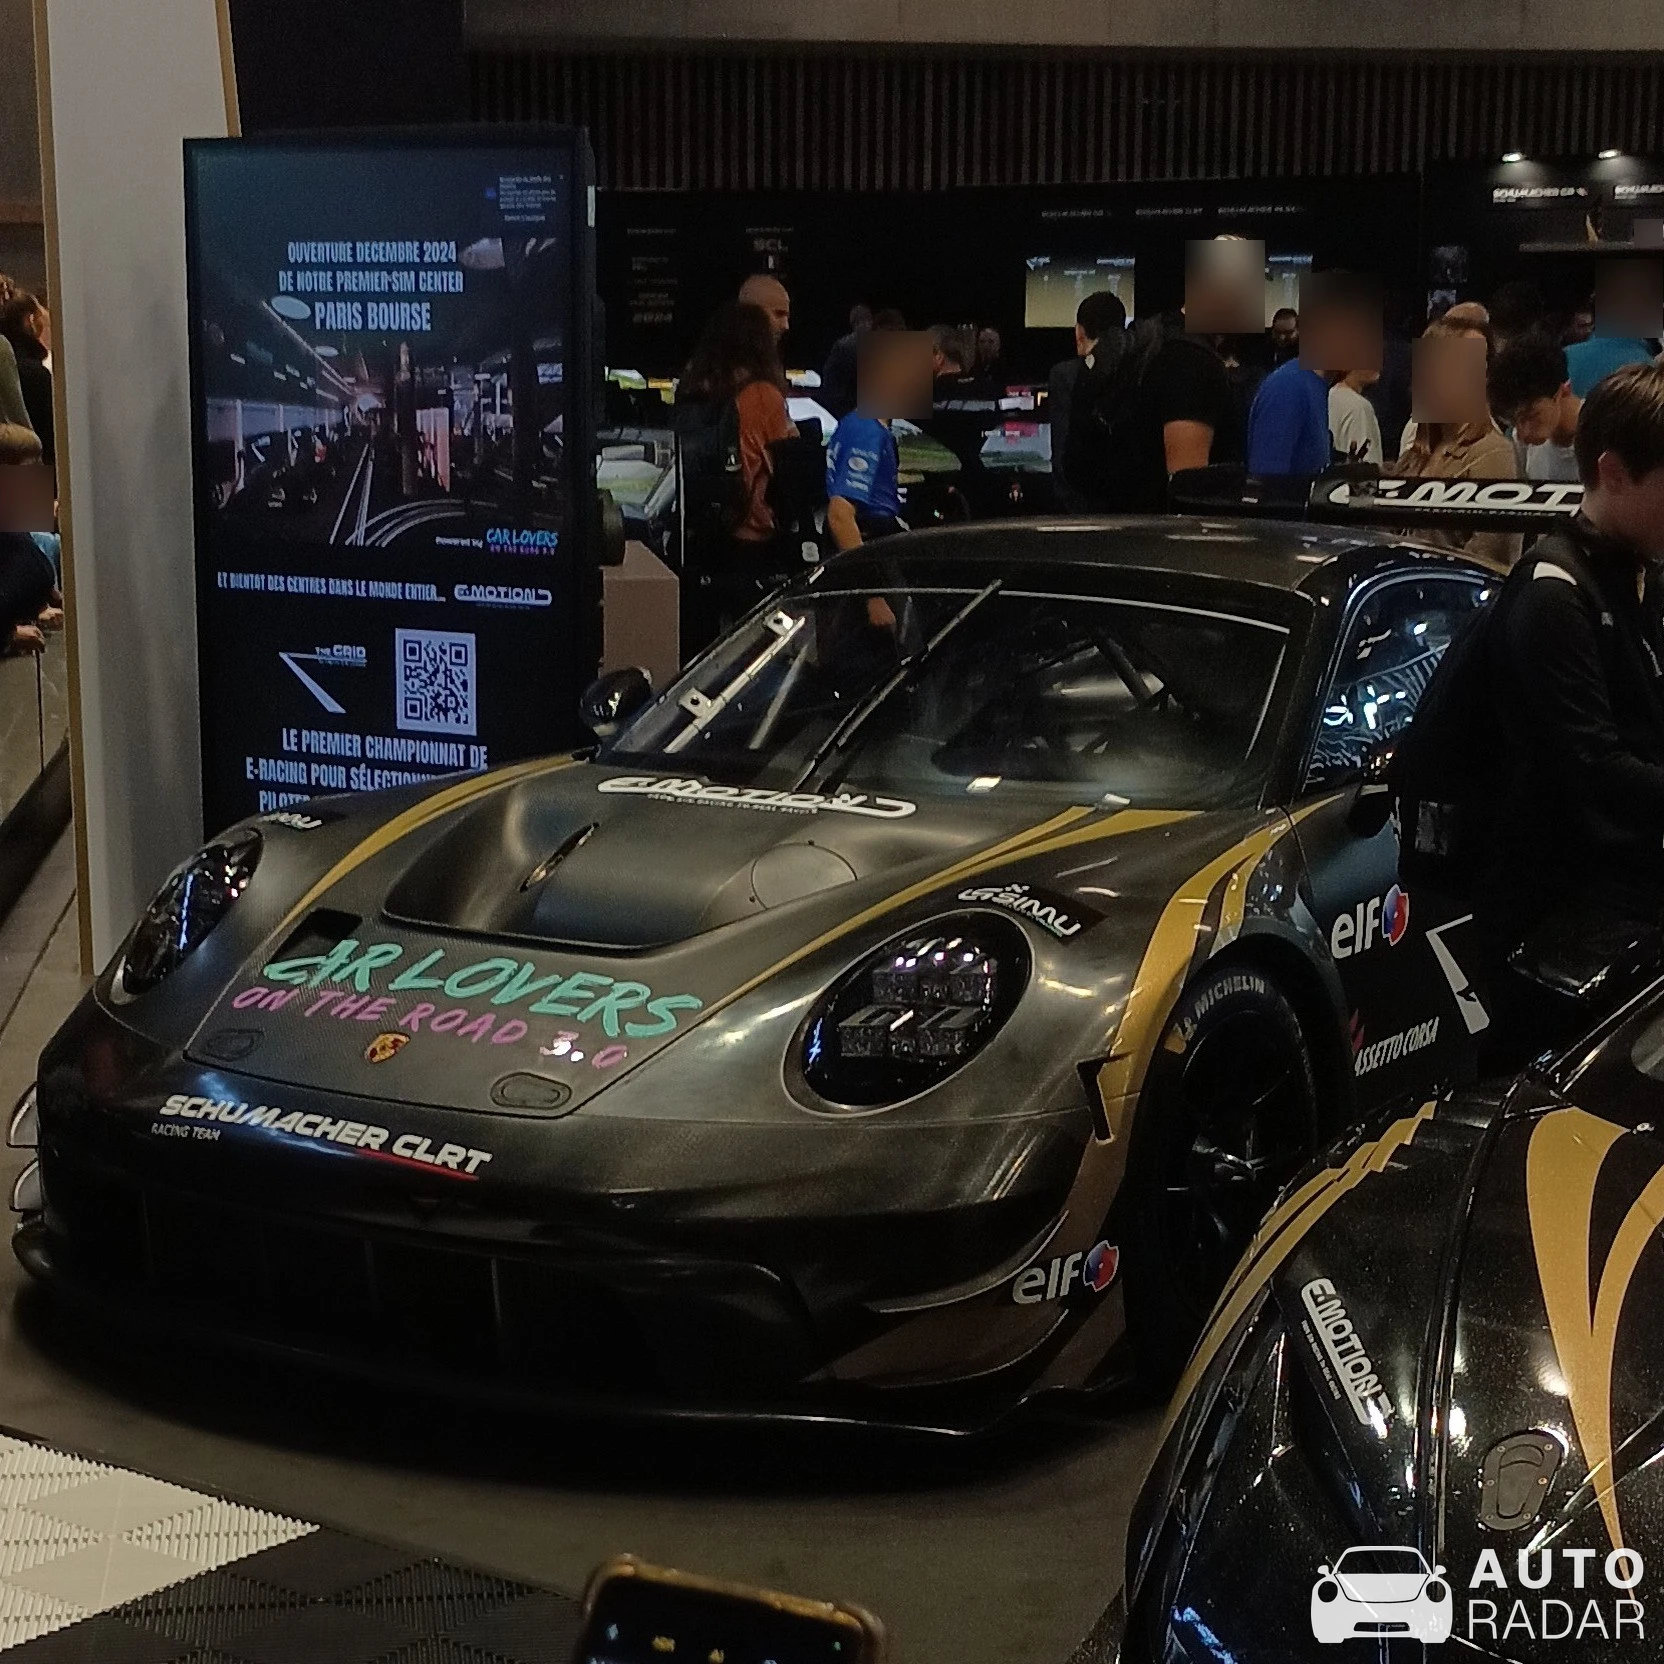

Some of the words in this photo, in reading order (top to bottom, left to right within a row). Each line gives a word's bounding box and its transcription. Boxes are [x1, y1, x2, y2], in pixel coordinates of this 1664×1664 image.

[288, 241, 353, 263] OUVERTURE
[356, 241, 420, 263] DECEMBRE
[423, 240, 457, 263] 2024
[279, 270, 294, 292] DE
[297, 270, 333, 292] NOTRE
[336, 270, 388, 293] PREMIER
[391, 270, 415, 292] SIM
[419, 270, 464, 293] CENTER
[315, 301, 363, 331] PARIS
[367, 301, 432, 331] BOURSE
[512, 529, 559, 548] LOVERS
[217, 572, 228, 588] ET
[267, 575, 285, 591] DES
[287, 576, 327, 594] CENTRES
[328, 578, 354, 596] DANS
[355, 580, 367, 597] LE
[369, 581, 403, 599] MONDE
[282, 727, 298, 751] LE
[302, 730, 362, 758] PREMIER
[365, 735, 466, 768] CHAMPIONNAT
[470, 745, 488, 769] DE
[246, 757, 307, 786] E-RACING
[311, 764, 347, 789] POUR
[1331, 897, 1380, 959] elf
[389, 949, 702, 1038] LOVERS
[1195, 976, 1265, 1020] MICHELIN
[232, 986, 300, 1012] ON
[304, 990, 397, 1021] THE
[399, 1003, 529, 1044] ROAD
[151, 1122, 190, 1138] RACING
[192, 1126, 221, 1141] TEAM
[159, 1095, 389, 1150] SCHUMACHER
[392, 1134, 493, 1174] CLRT
[1012, 1252, 1083, 1304] elf
